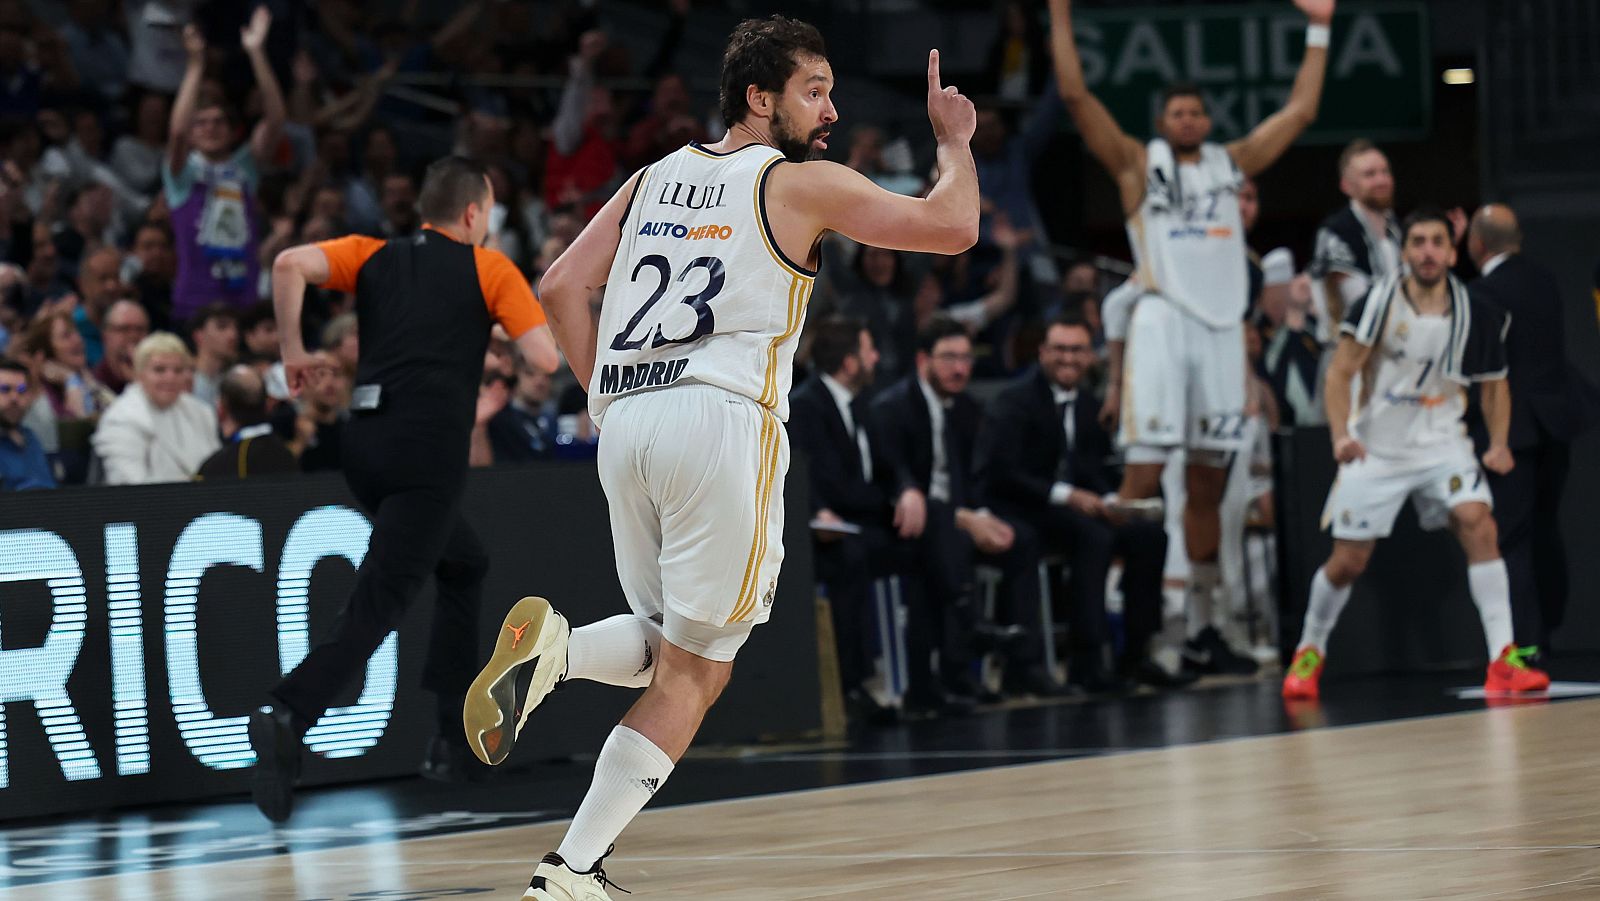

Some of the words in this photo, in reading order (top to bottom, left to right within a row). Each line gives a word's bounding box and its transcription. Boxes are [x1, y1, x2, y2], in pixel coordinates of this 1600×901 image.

[658, 182, 725, 209] LLULL
[638, 222, 732, 241] AUTOHERO
[609, 254, 726, 351] 23
[599, 358, 690, 394] MADRID
[1417, 357, 1434, 389] 7
[0, 505, 399, 788] RICO
